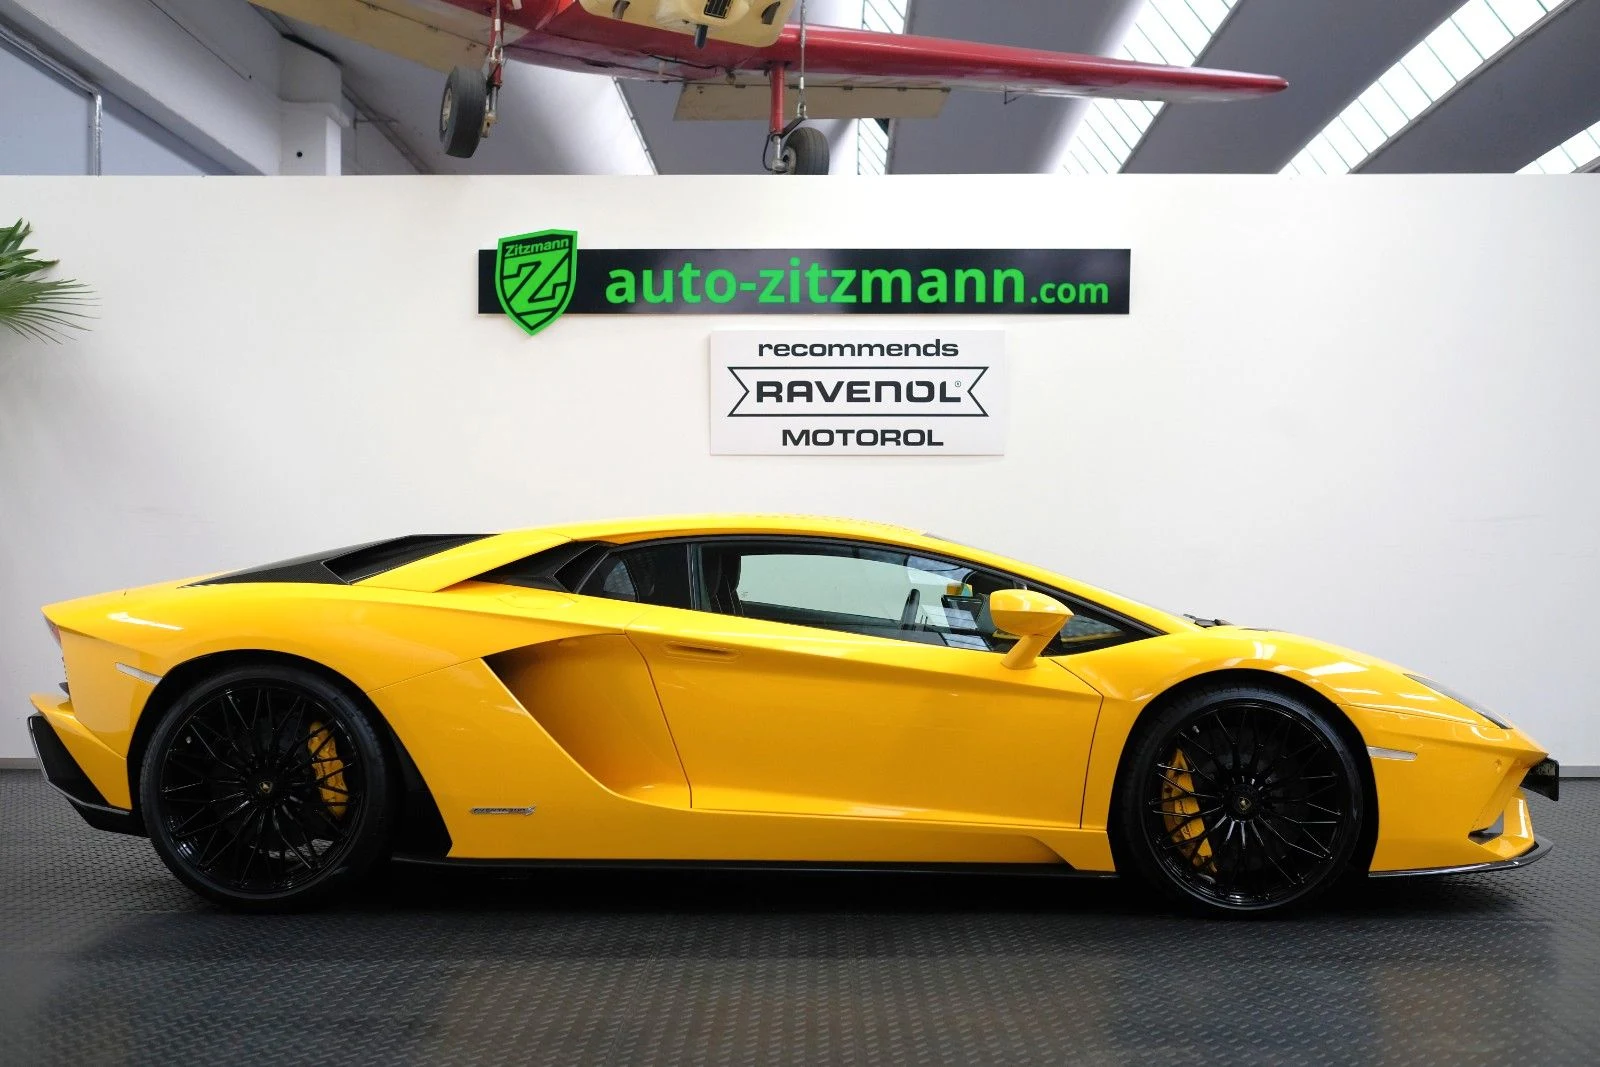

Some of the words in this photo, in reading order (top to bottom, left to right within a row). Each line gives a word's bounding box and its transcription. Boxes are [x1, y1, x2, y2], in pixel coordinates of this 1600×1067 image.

[505, 238, 569, 257] Zitzmann
[605, 257, 1109, 304] auto-zitzmann.com
[758, 339, 959, 357] recommends
[782, 429, 944, 446] MOTOROL
